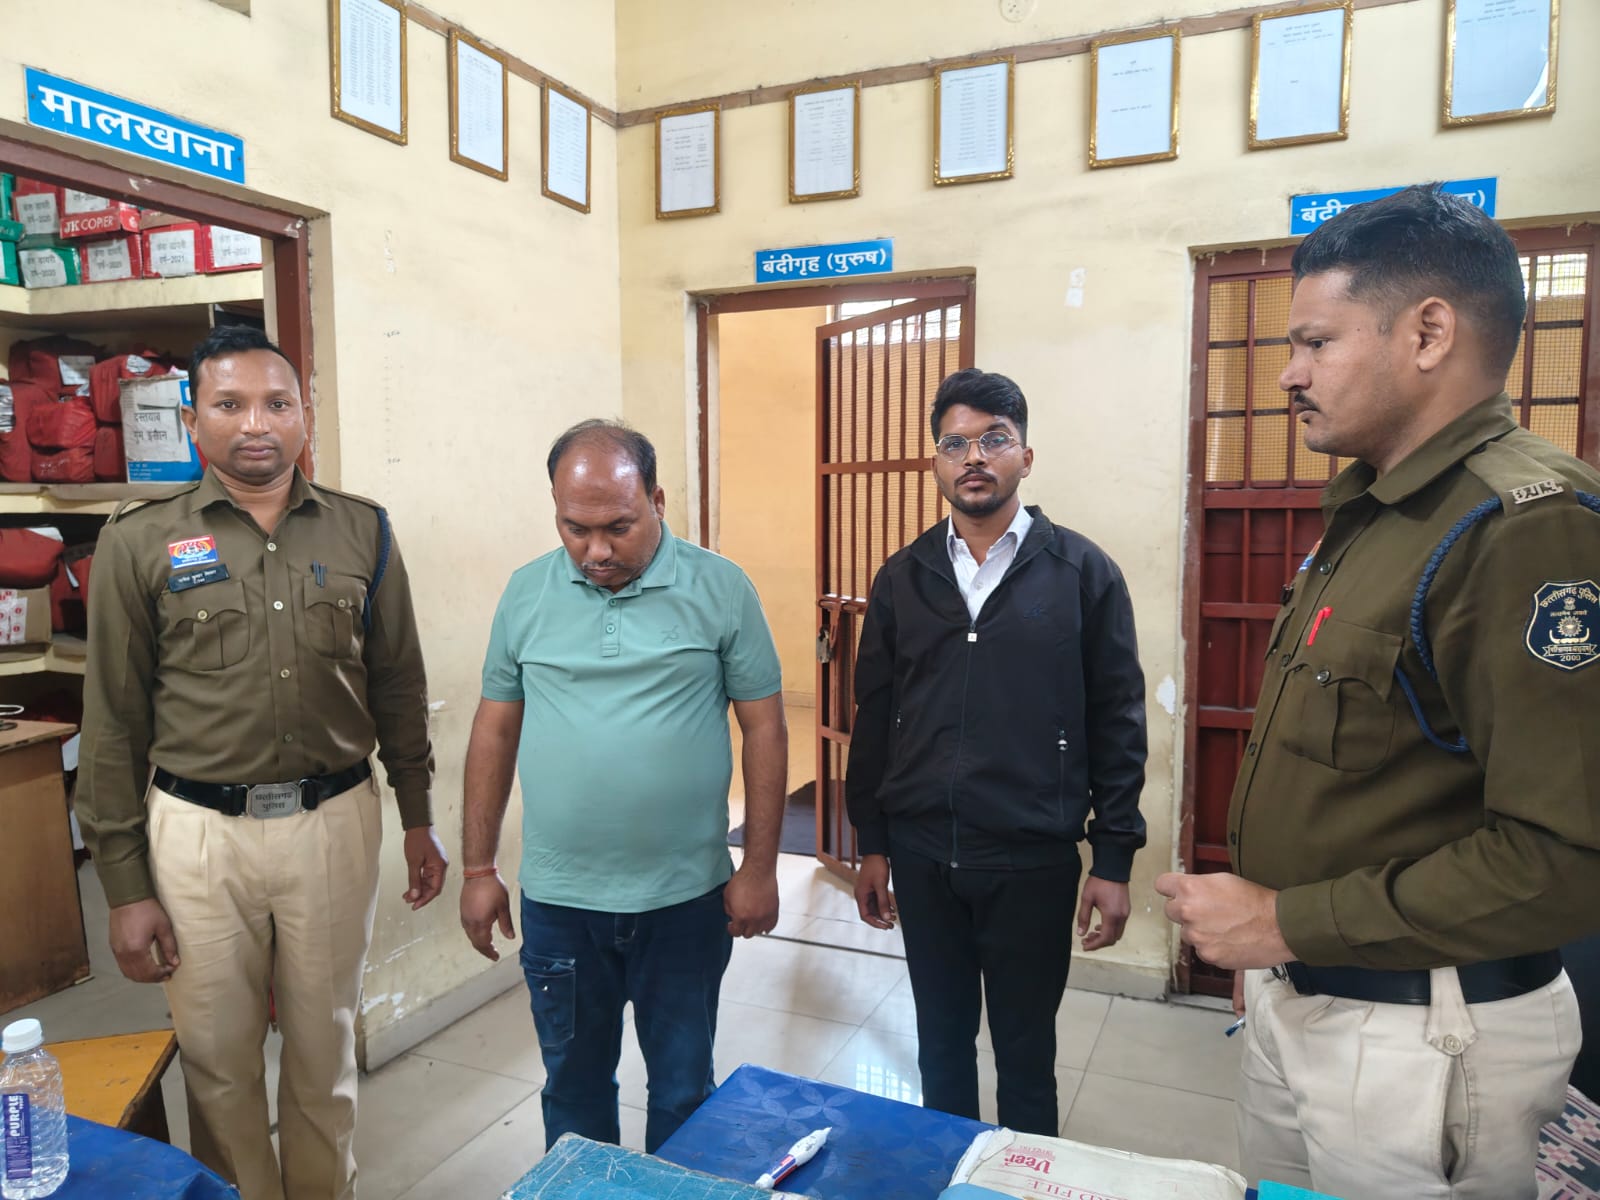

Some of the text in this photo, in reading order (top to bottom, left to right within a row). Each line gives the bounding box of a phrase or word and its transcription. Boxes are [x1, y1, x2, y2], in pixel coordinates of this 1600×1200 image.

[38, 85, 235, 171] मालखाना
[1301, 198, 1354, 223] बंदी
[64, 216, 114, 234] JK COPIER
[762, 248, 887, 276] बंदीगृह (पुरुष)
[1560, 654, 1581, 662] 2000
[9, 1095, 20, 1137] PURPLE
[1004, 1153, 1050, 1174] Veer
[1027, 1180, 1072, 1198] FILE
